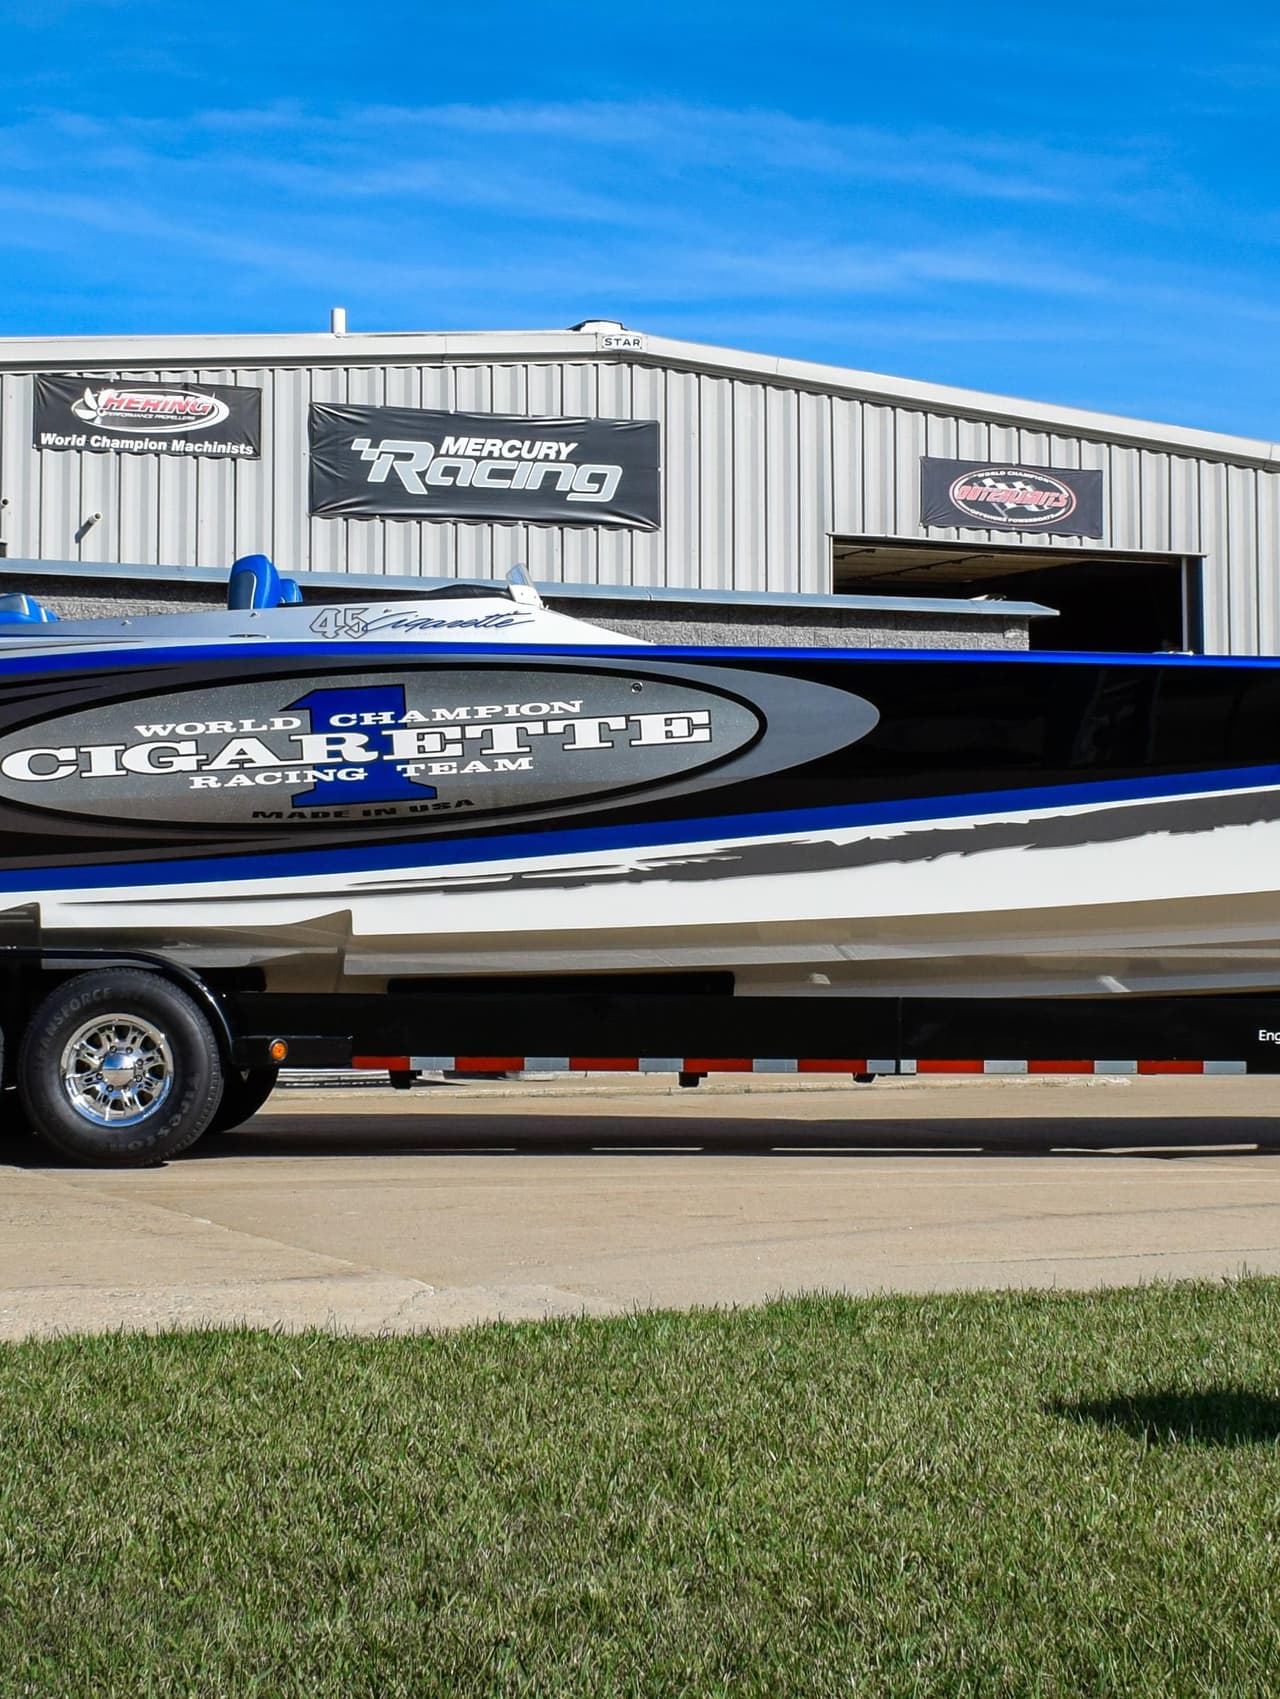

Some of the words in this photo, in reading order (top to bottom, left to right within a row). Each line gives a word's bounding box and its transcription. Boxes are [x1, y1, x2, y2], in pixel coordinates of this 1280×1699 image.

[604, 337, 641, 348] STAR
[102, 393, 212, 416] HERING
[41, 433, 86, 447] World
[90, 435, 167, 452] Champion
[172, 439, 254, 456] Machinists
[439, 436, 579, 461] MERCURY
[351, 438, 623, 502] Racing
[309, 608, 370, 640] 45
[363, 610, 536, 633] Cigarette
[134, 717, 302, 737] WORLD
[329, 701, 583, 728] CHAMPION
[0, 709, 713, 782] CIGARETTE
[188, 767, 369, 790] RACING
[396, 757, 534, 778] TEAM
[251, 810, 350, 819] MADE
[361, 807, 397, 817] IN
[409, 799, 475, 813] USA
